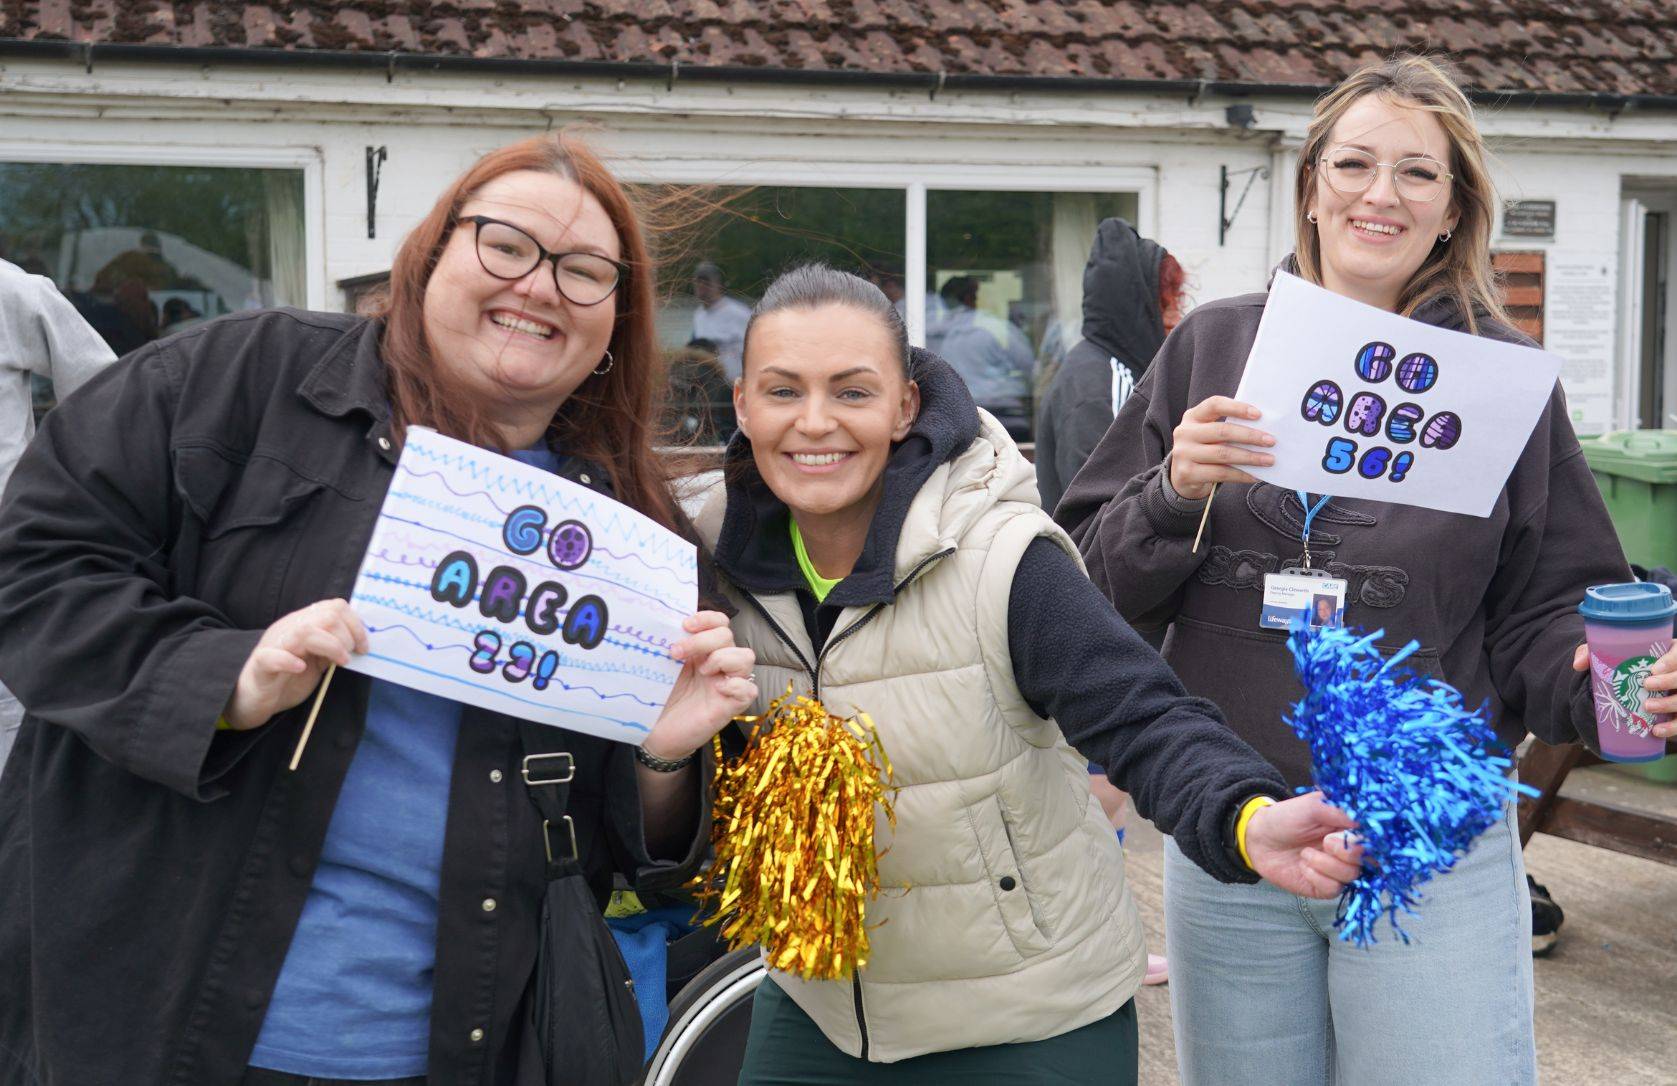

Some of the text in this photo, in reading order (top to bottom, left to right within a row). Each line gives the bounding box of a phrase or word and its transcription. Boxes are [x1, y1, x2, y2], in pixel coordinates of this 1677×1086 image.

[1354, 341, 1439, 394] GO
[1301, 379, 1462, 450] AREA
[1321, 436, 1414, 483] 56!
[503, 505, 593, 570] GO
[430, 551, 609, 650] AREA
